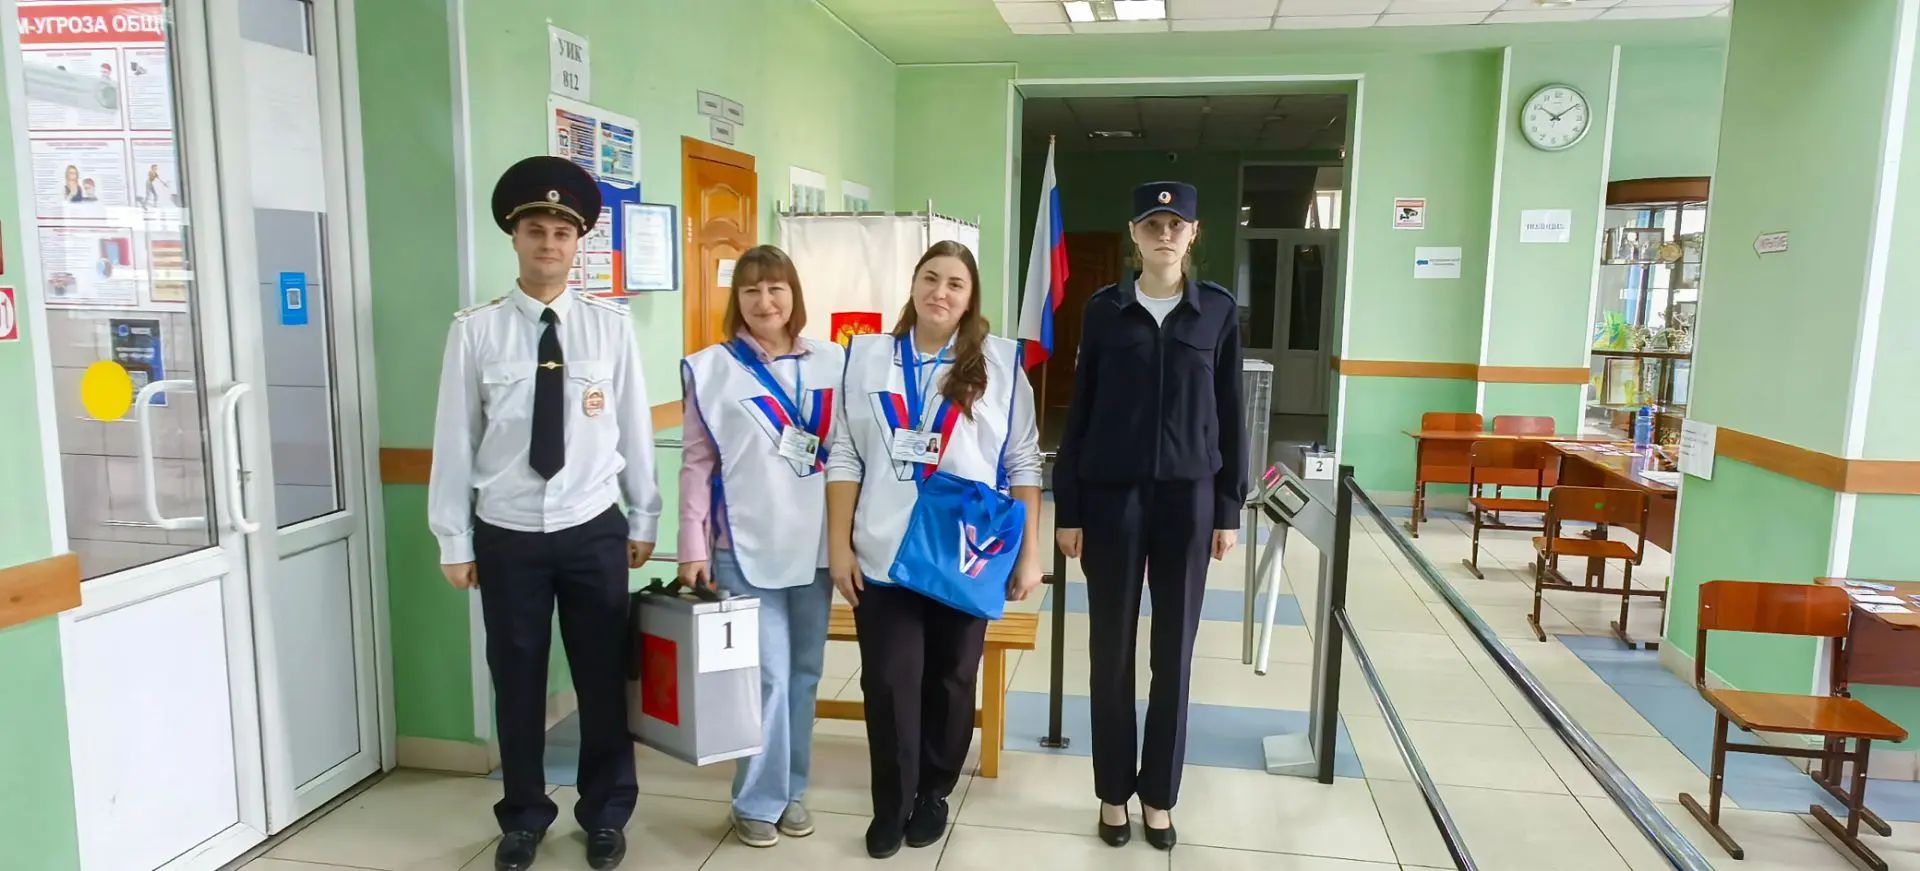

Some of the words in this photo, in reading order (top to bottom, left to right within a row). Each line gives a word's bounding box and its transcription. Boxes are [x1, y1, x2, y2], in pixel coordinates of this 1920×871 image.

[558, 38, 583, 64] УИК
[563, 70, 580, 91] 812
[1316, 461, 1323, 472] 2
[723, 621, 735, 650] 1
